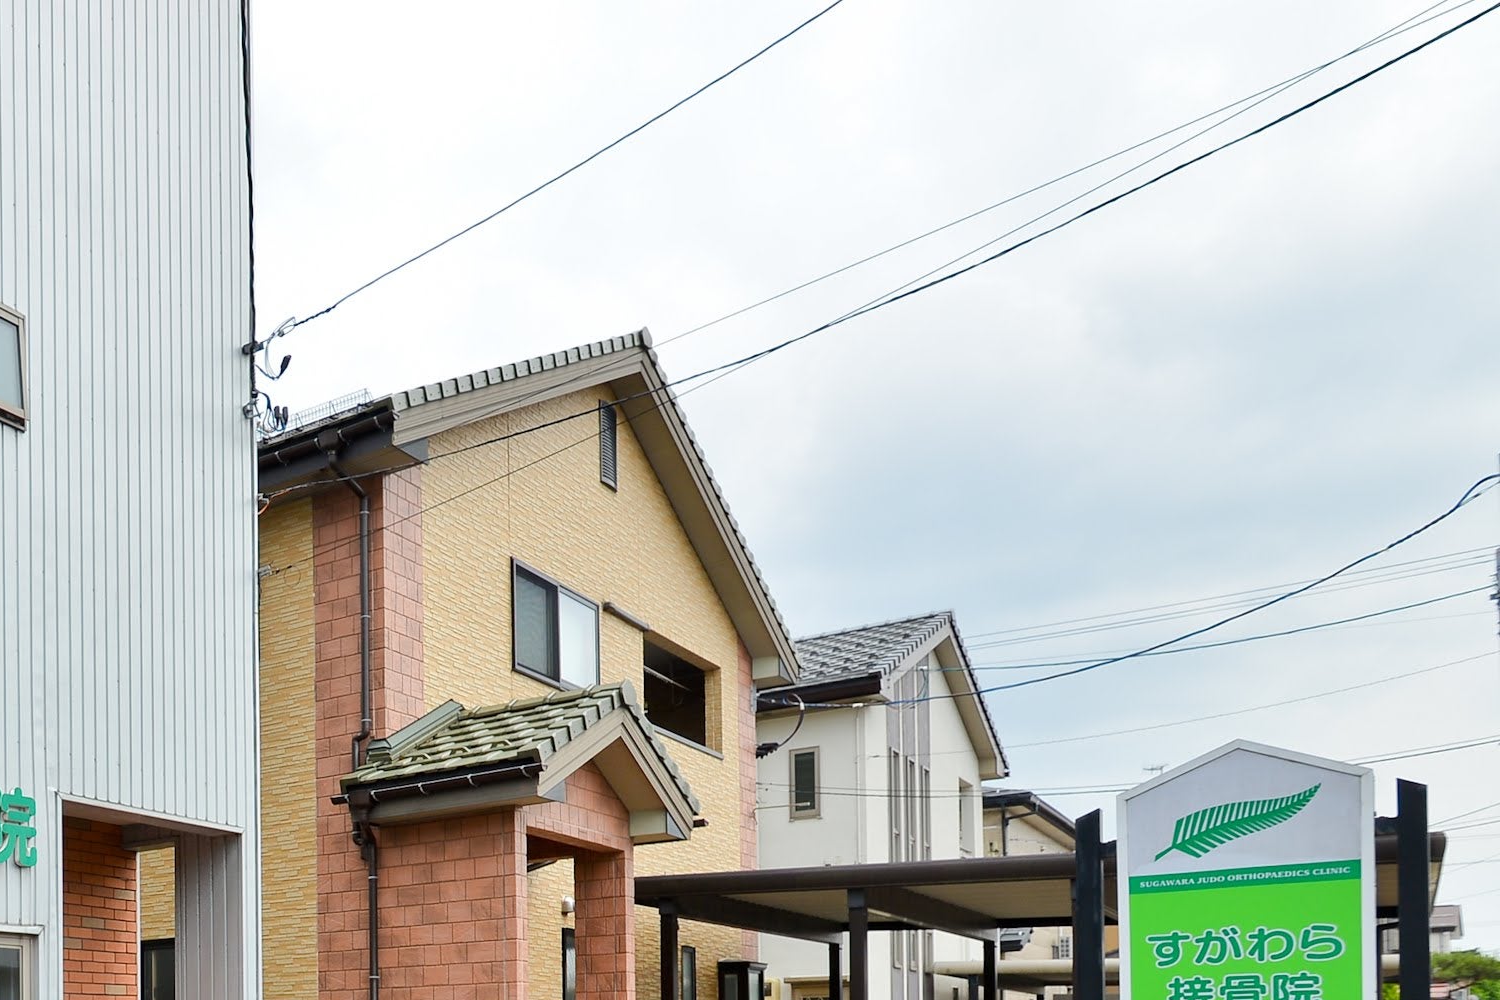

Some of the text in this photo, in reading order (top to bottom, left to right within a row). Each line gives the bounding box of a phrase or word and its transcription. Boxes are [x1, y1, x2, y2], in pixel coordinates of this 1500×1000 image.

[1139, 866, 1351, 888] SUGAWARA JUDO ORTHOPAEDICS CLINIC
[1146, 923, 1345, 968] すがわら
